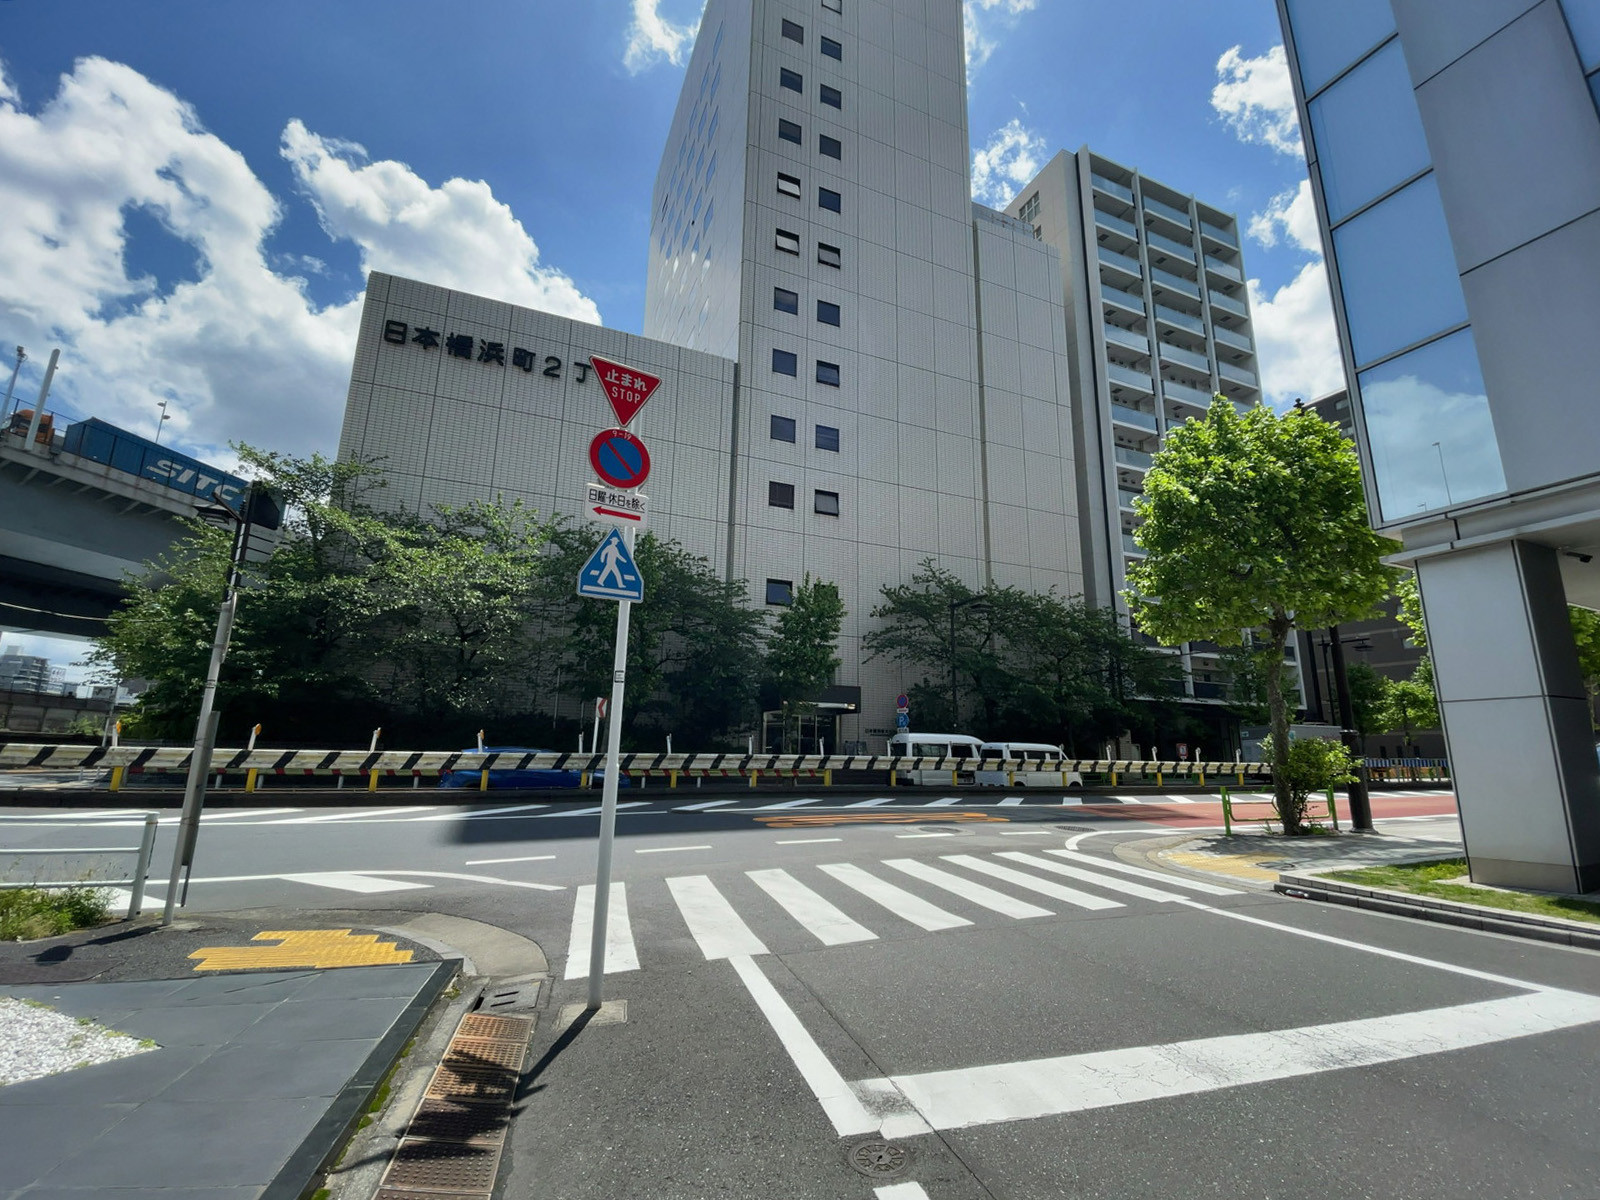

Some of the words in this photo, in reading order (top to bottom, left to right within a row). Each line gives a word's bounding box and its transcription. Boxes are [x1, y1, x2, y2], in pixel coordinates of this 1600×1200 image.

[604, 368, 647, 392] 止まれ
[611, 386, 641, 404] STOP
[146, 460, 240, 501] SITC
